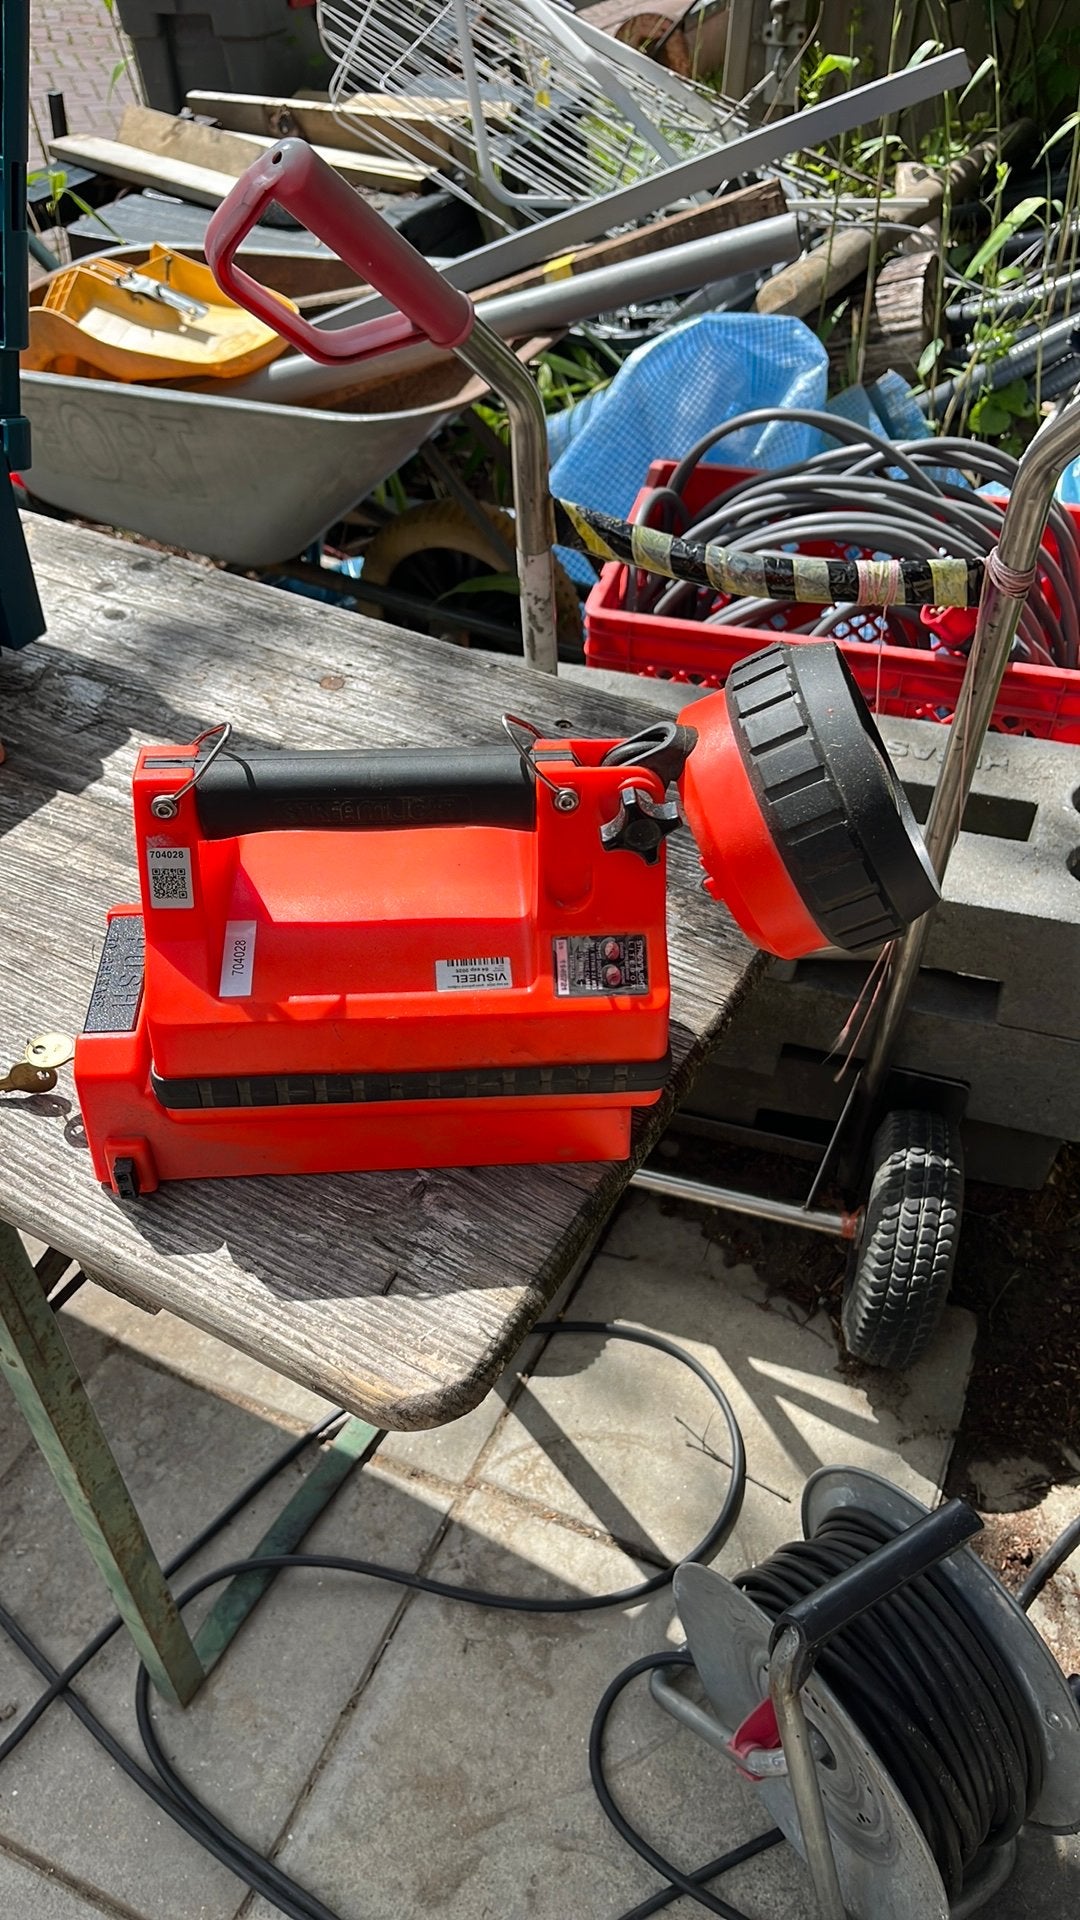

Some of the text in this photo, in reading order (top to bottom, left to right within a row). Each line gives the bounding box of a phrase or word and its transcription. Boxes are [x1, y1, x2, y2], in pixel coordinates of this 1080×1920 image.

[149, 850, 184, 859] 704028
[231, 939, 246, 976] 704028
[94, 957, 113, 1008] RELEASE
[452, 972, 507, 983] VISUEEL
